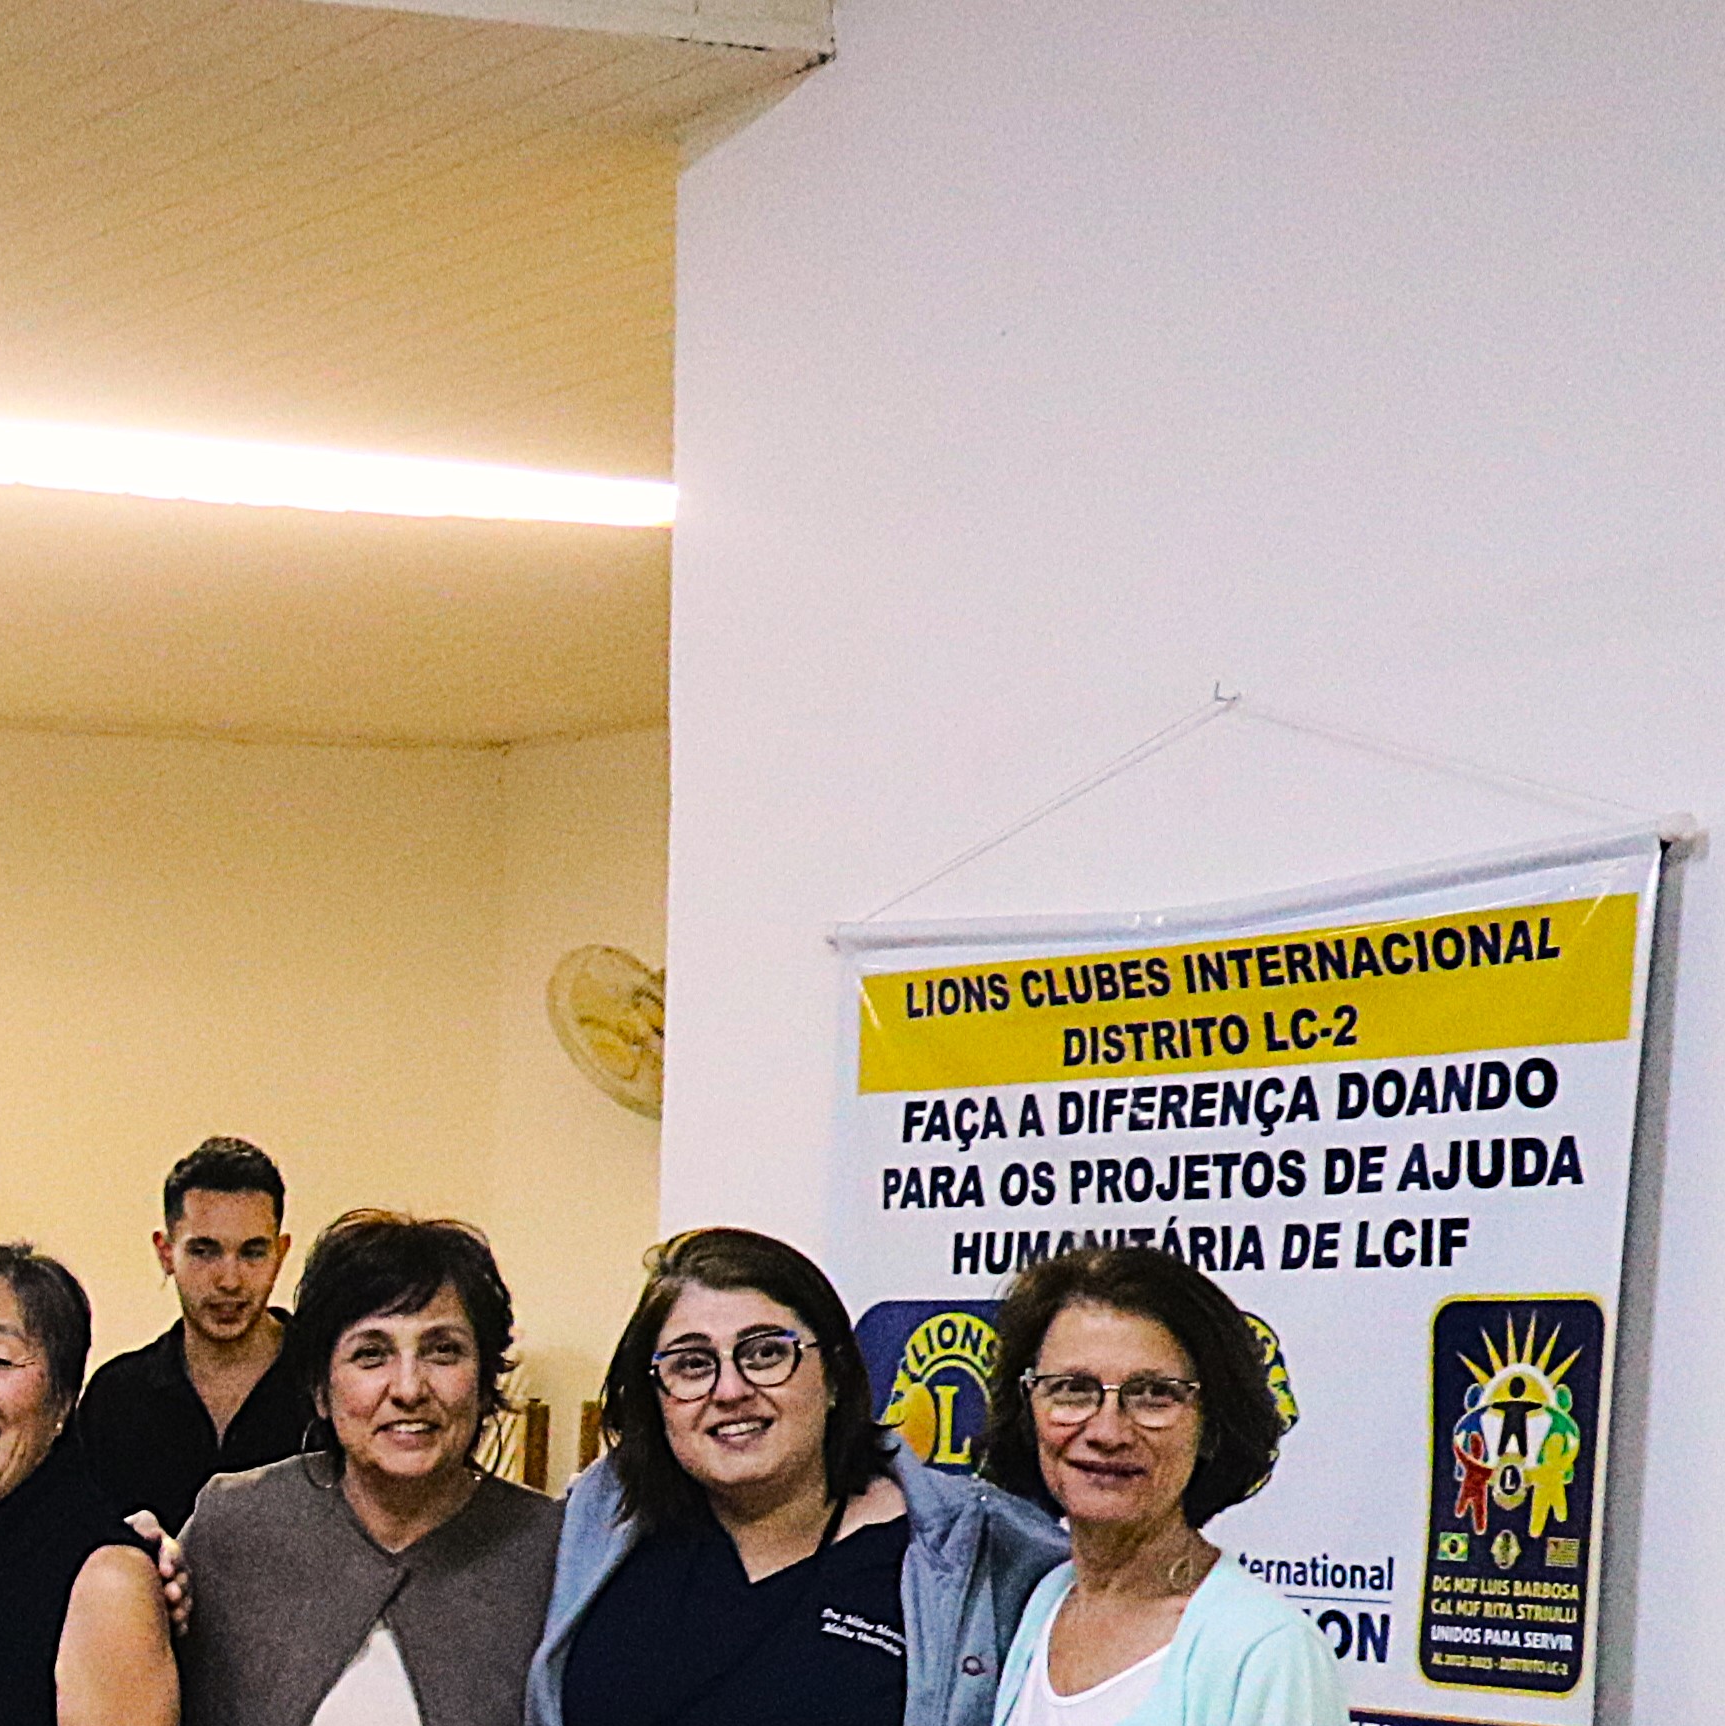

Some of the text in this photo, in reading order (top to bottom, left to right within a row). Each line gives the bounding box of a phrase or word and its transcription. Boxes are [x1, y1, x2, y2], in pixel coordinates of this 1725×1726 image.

[905, 917, 1561, 1019] LIONS CLUBES INTERNACIONAL
[1063, 1005, 1358, 1068] DISTRITO LC-2
[902, 1057, 1559, 1152] FAÇA A DIFERENÇA DOANDO
[883, 1136, 1584, 1210] PARA OS PROJETOS DE AJUDA
[1281, 1224, 1341, 1271] DE
[1356, 1217, 1471, 1268] LCIF
[1480, 1578, 1510, 1596] LUIS
[1513, 1580, 1579, 1599] BARBOSA
[1483, 1602, 1513, 1619] RITA
[1302, 1608, 1391, 1663] ON
[1431, 1625, 1573, 1650] UNIDOS PARA SERVIR
